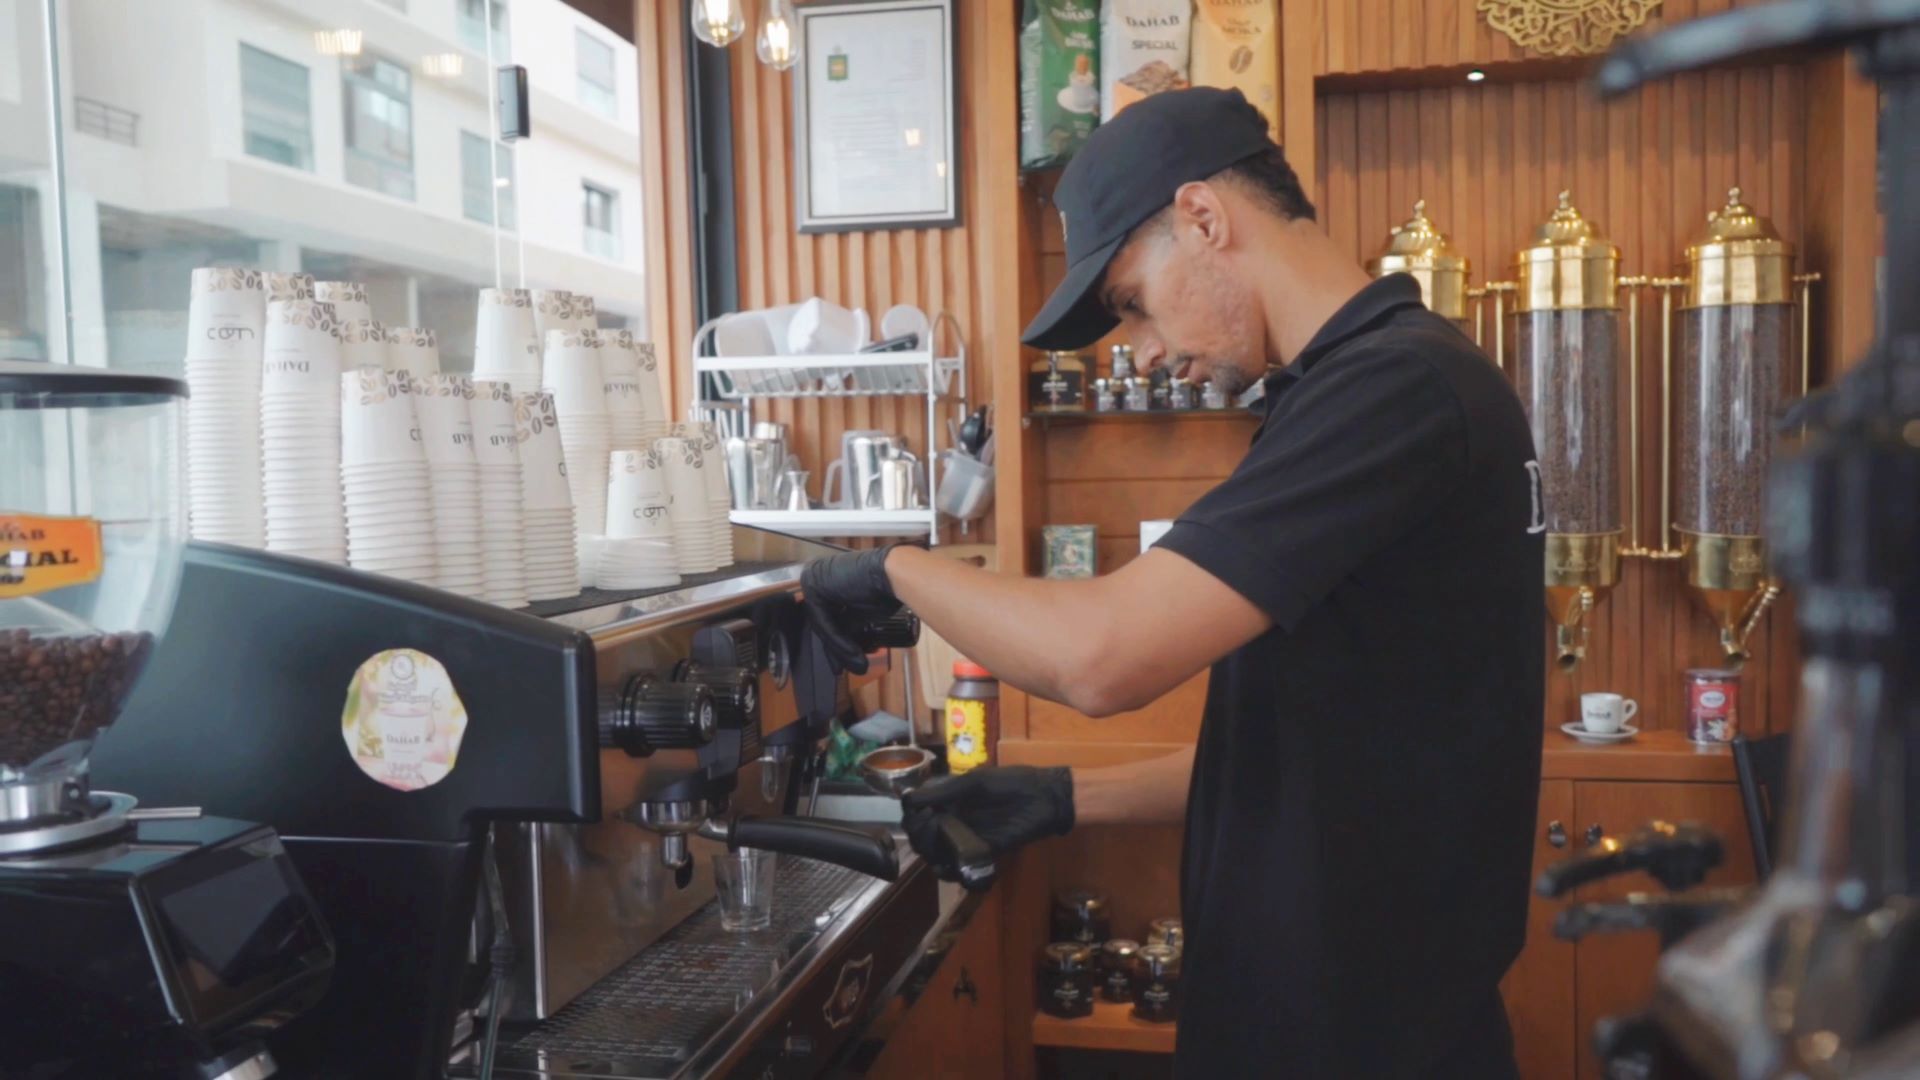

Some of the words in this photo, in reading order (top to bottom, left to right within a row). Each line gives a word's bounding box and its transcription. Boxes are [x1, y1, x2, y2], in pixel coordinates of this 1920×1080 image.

[1125, 15, 1180, 28] DAHAB
[1131, 39, 1178, 51] SPECIAL
[386, 733, 421, 745] DAHAB
